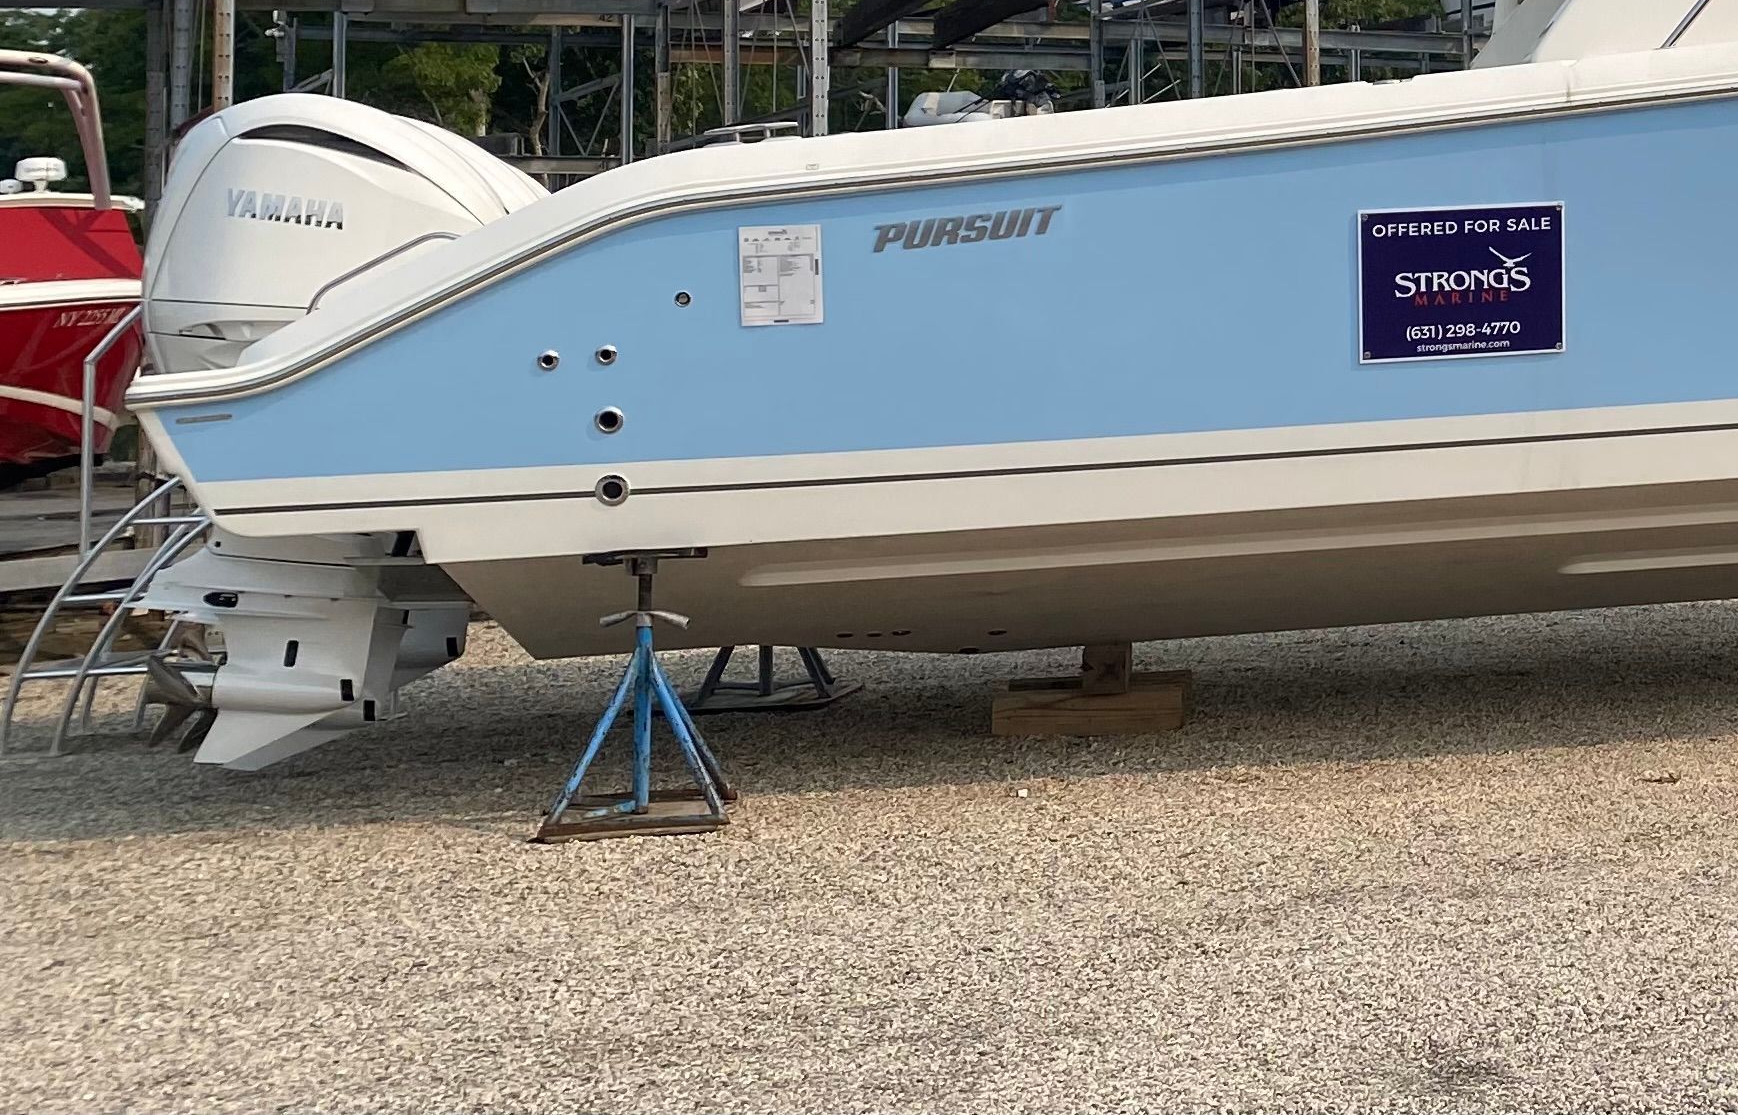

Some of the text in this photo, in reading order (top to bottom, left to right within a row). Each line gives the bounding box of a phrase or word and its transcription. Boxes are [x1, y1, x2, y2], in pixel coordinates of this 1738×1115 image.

[226, 187, 343, 231] YAMAHA
[873, 204, 1063, 254] PURSUIT
[1372, 216, 1551, 238] OFFERED FOR SALE
[1414, 289, 1510, 306] MARINE
[1406, 321, 1521, 341] (631) 298-4770
[1416, 340, 1510, 353] strongsmarine.com
